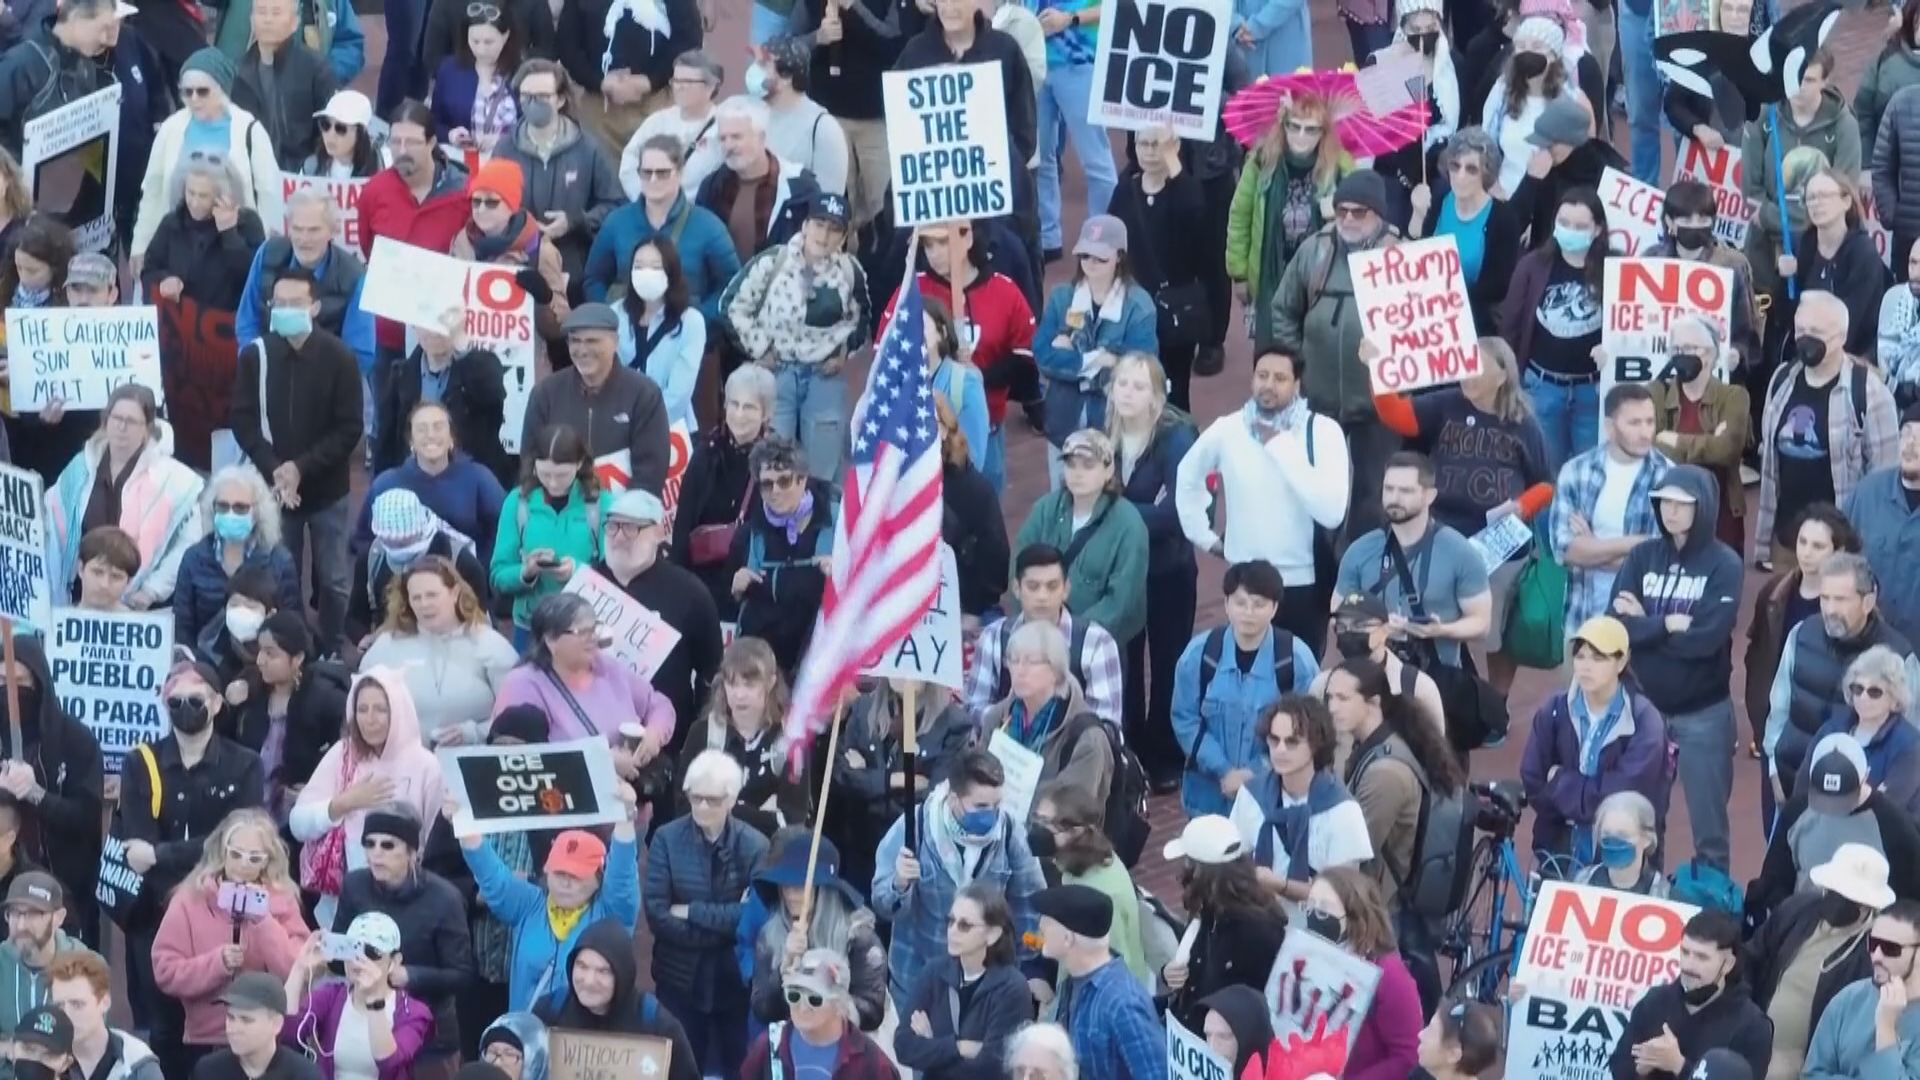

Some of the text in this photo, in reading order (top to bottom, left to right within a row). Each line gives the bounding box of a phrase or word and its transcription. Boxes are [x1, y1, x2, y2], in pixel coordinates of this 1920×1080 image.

[1111, 0, 1216, 61] NO
[908, 72, 974, 109] STOP
[1103, 52, 1209, 116] ICE
[920, 109, 969, 145] THE
[900, 146, 997, 186] DEPOR-
[897, 180, 1005, 222] TATIONS
[1608, 177, 1666, 227] ICE
[1618, 263, 1725, 311] NO
[13, 314, 52, 346] THE
[464, 311, 531, 342] ROOPS
[1391, 315, 1459, 356] MUST
[1611, 304, 1644, 331] ICE
[33, 347, 131, 375] SUN WILL
[1377, 344, 1479, 389] GO NOW
[33, 378, 82, 403] MELT
[0, 472, 36, 520] ND
[56, 617, 163, 651] ¡DINERO
[81, 645, 116, 661] PARA
[862, 633, 948, 674] AY
[52, 658, 162, 697] PUEBLO,
[93, 698, 160, 726] PARA
[91, 726, 161, 747] UERRA!
[498, 753, 545, 772] ICE
[496, 773, 557, 792] OUT
[498, 794, 537, 812] OF
[1545, 889, 1685, 954] NO
[1528, 935, 1569, 970] ICE
[1585, 943, 1686, 987] TROOPS
[1571, 977, 1591, 1002] IN
